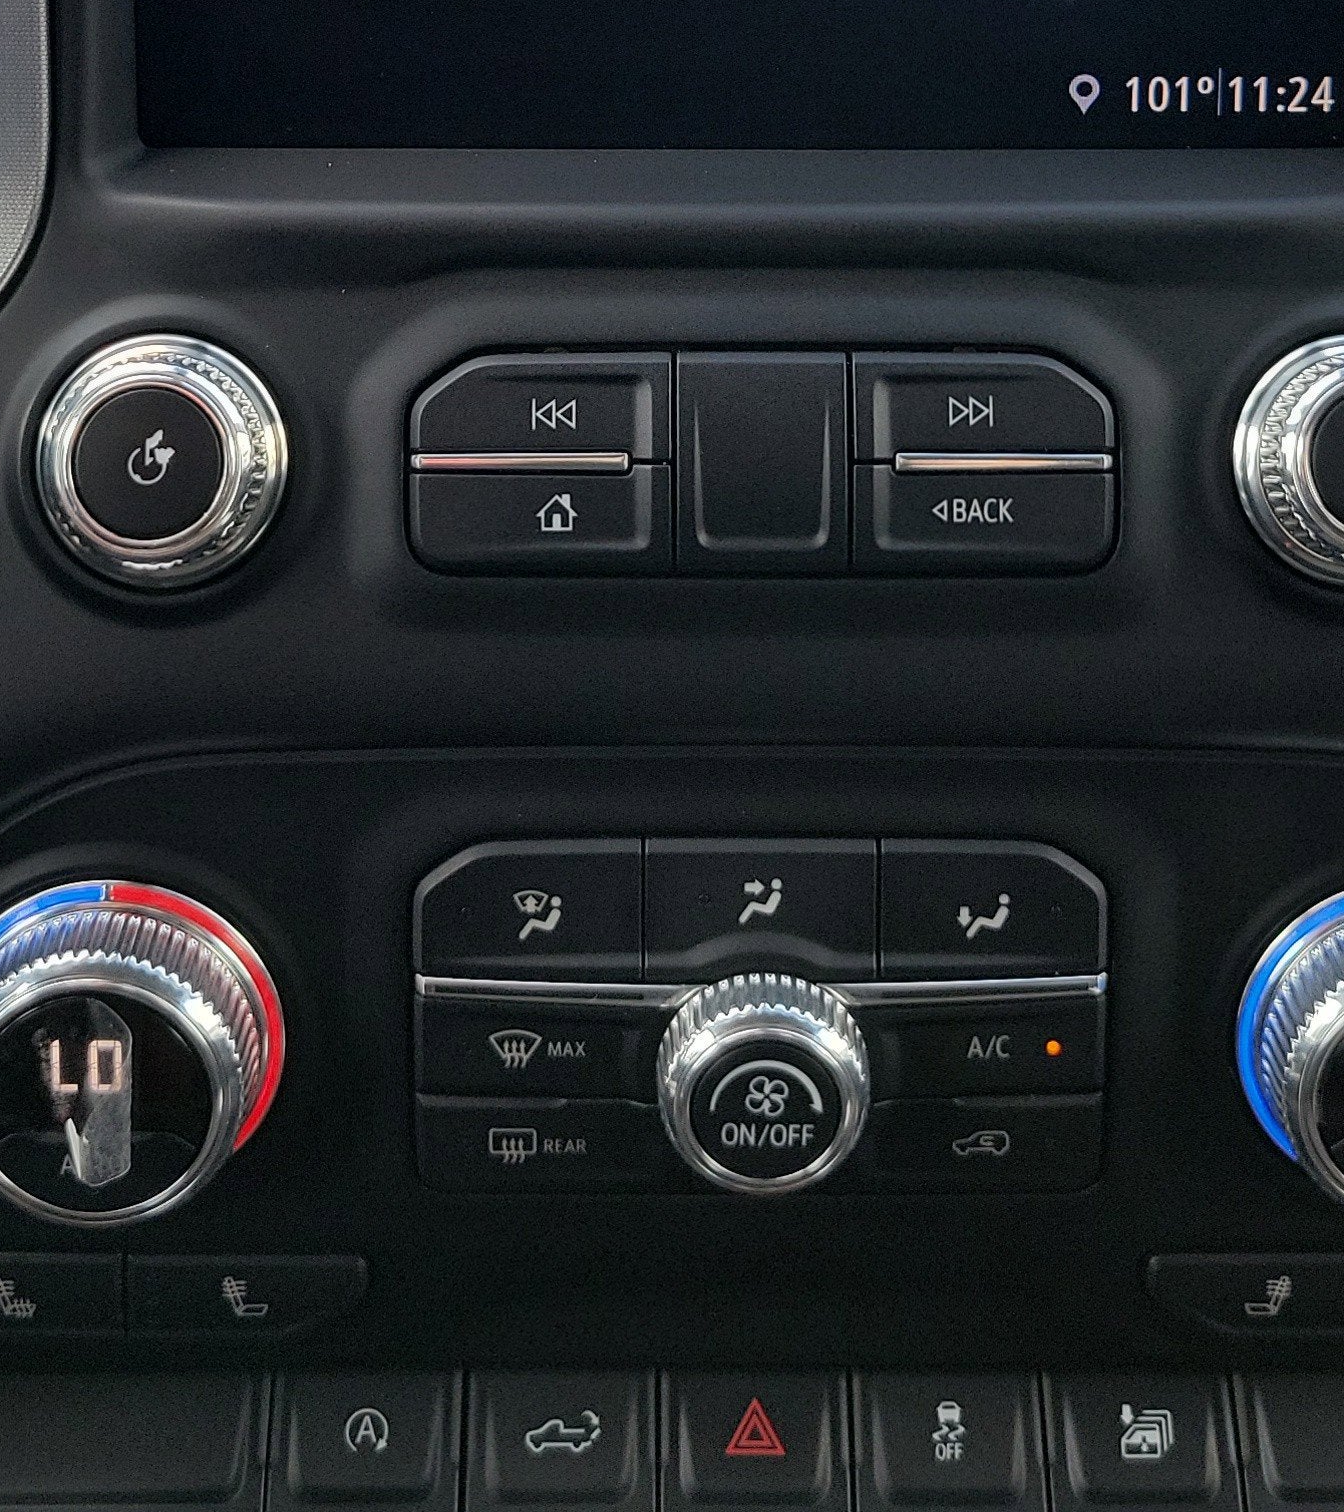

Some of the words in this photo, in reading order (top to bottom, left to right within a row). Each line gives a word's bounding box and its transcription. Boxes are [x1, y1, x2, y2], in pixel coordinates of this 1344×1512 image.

[1228, 76, 1335, 113] 11:24
[952, 498, 1014, 524] BACK
[547, 1040, 587, 1059] MAX
[967, 1034, 1011, 1061] A/C
[543, 1138, 588, 1156] REAR
[720, 1120, 816, 1150] ON/OFF
[935, 1443, 965, 1461] OFF
